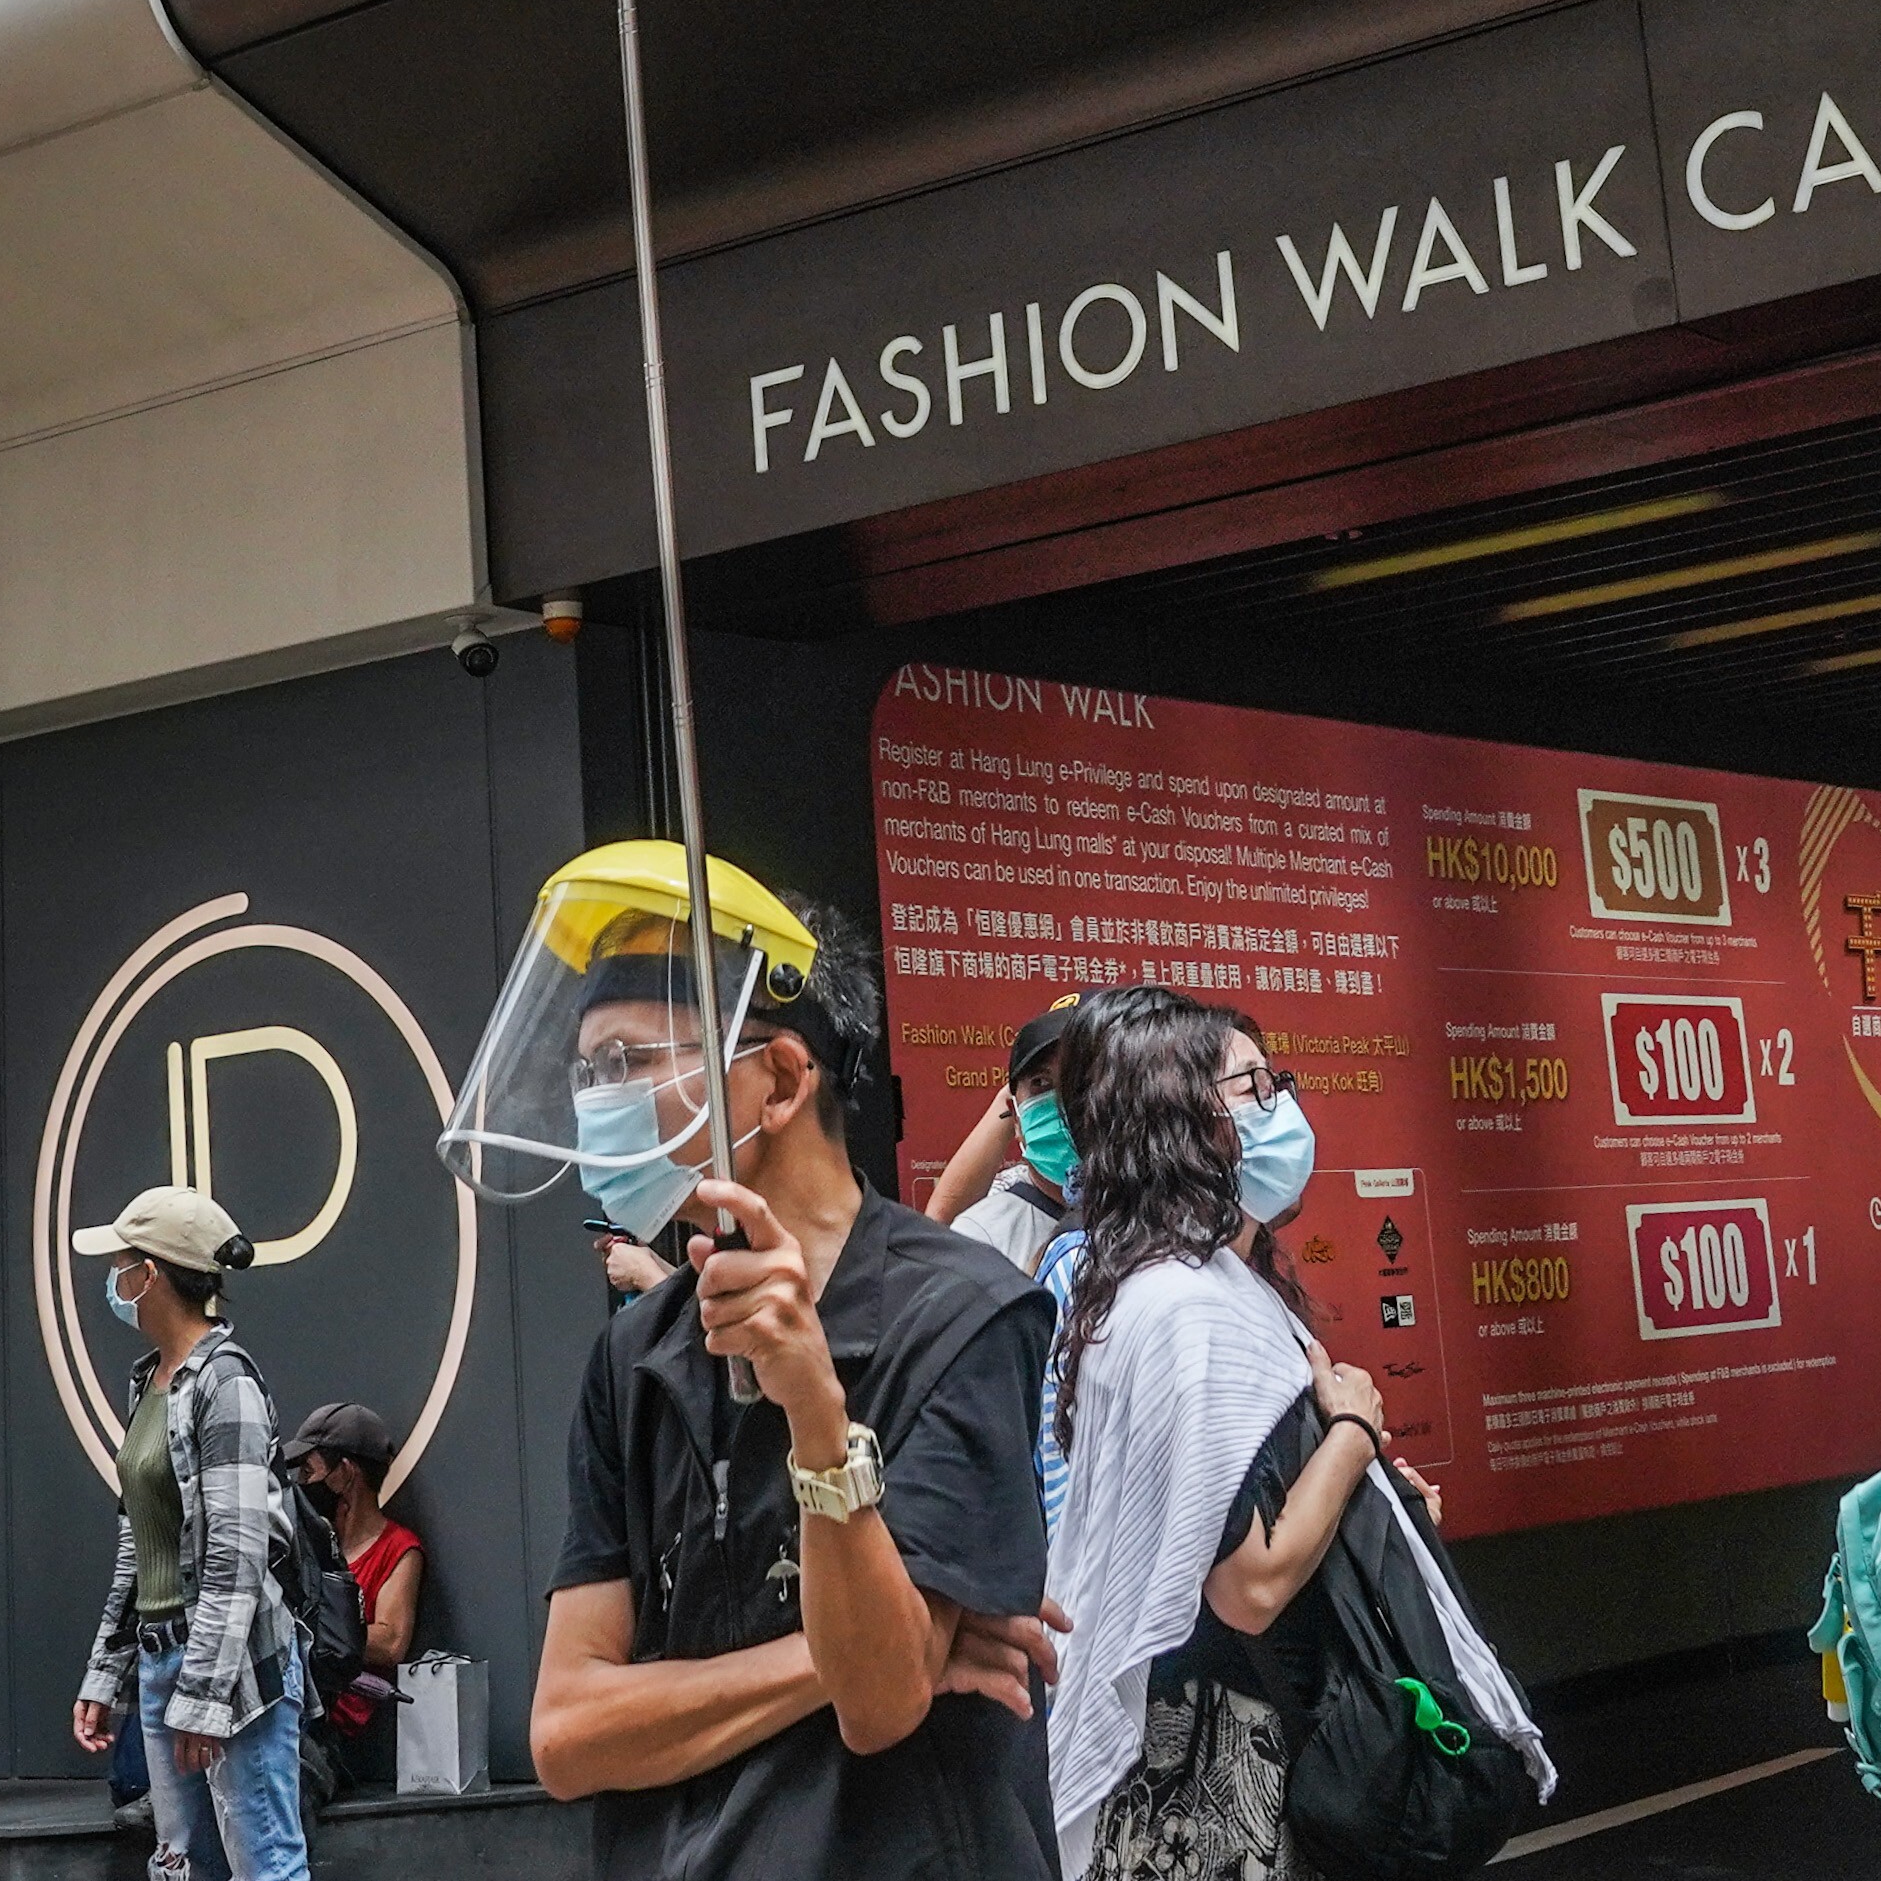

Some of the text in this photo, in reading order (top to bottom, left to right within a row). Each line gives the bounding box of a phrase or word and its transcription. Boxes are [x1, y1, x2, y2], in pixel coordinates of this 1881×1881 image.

[750, 250, 1240, 473] FASHION
[1275, 145, 1638, 331] WALK
[1060, 683, 1155, 730] WALK
[878, 736, 1388, 815] Register at Hang Lung e-Privilege and spend upon designated amount at
[880, 778, 1391, 848] non-F&B merchants to redeem e-Cash Vouchers from a curated mix of
[1422, 804, 1463, 827] Spending
[1463, 807, 1496, 826] Amount
[883, 816, 967, 844] merchants
[971, 821, 987, 845] of
[990, 824, 1031, 855] Hang
[1034, 826, 1072, 858] Lung
[1122, 836, 1137, 858] at
[1140, 840, 1170, 864] your
[1173, 839, 1233, 869] disposal!
[1235, 844, 1287, 875] Multiple
[1289, 849, 1348, 877] Merchant
[1349, 855, 1394, 880] e-Cash
[1425, 834, 1559, 891] HK$10,000
[1607, 816, 1704, 903] $500
[885, 849, 1370, 914] Vouchers can be used in one transaction. Enjoy the unlimited privileges!
[1432, 896, 1442, 910] or
[1443, 895, 1471, 911] above
[901, 1023, 957, 1045] Fashion
[961, 1025, 996, 1047] Walk
[1292, 1033, 1340, 1056] (Victoria
[1342, 1035, 1370, 1055] Peak
[1445, 1021, 1487, 1042] Spending
[1487, 1023, 1520, 1041] Amount
[945, 1065, 988, 1088] Grand
[1331, 1071, 1354, 1091] Kok
[1449, 1051, 1569, 1107] HK$1,500
[1634, 1016, 1726, 1102] $100
[1456, 1117, 1466, 1131] or
[1467, 1114, 1494, 1131] above
[1466, 1226, 1510, 1248] Spending
[1510, 1223, 1543, 1243] Amount
[1471, 1253, 1569, 1308] HK$800
[1659, 1222, 1751, 1312] $100
[1477, 1322, 1488, 1338] or
[1488, 1319, 1517, 1338] above
